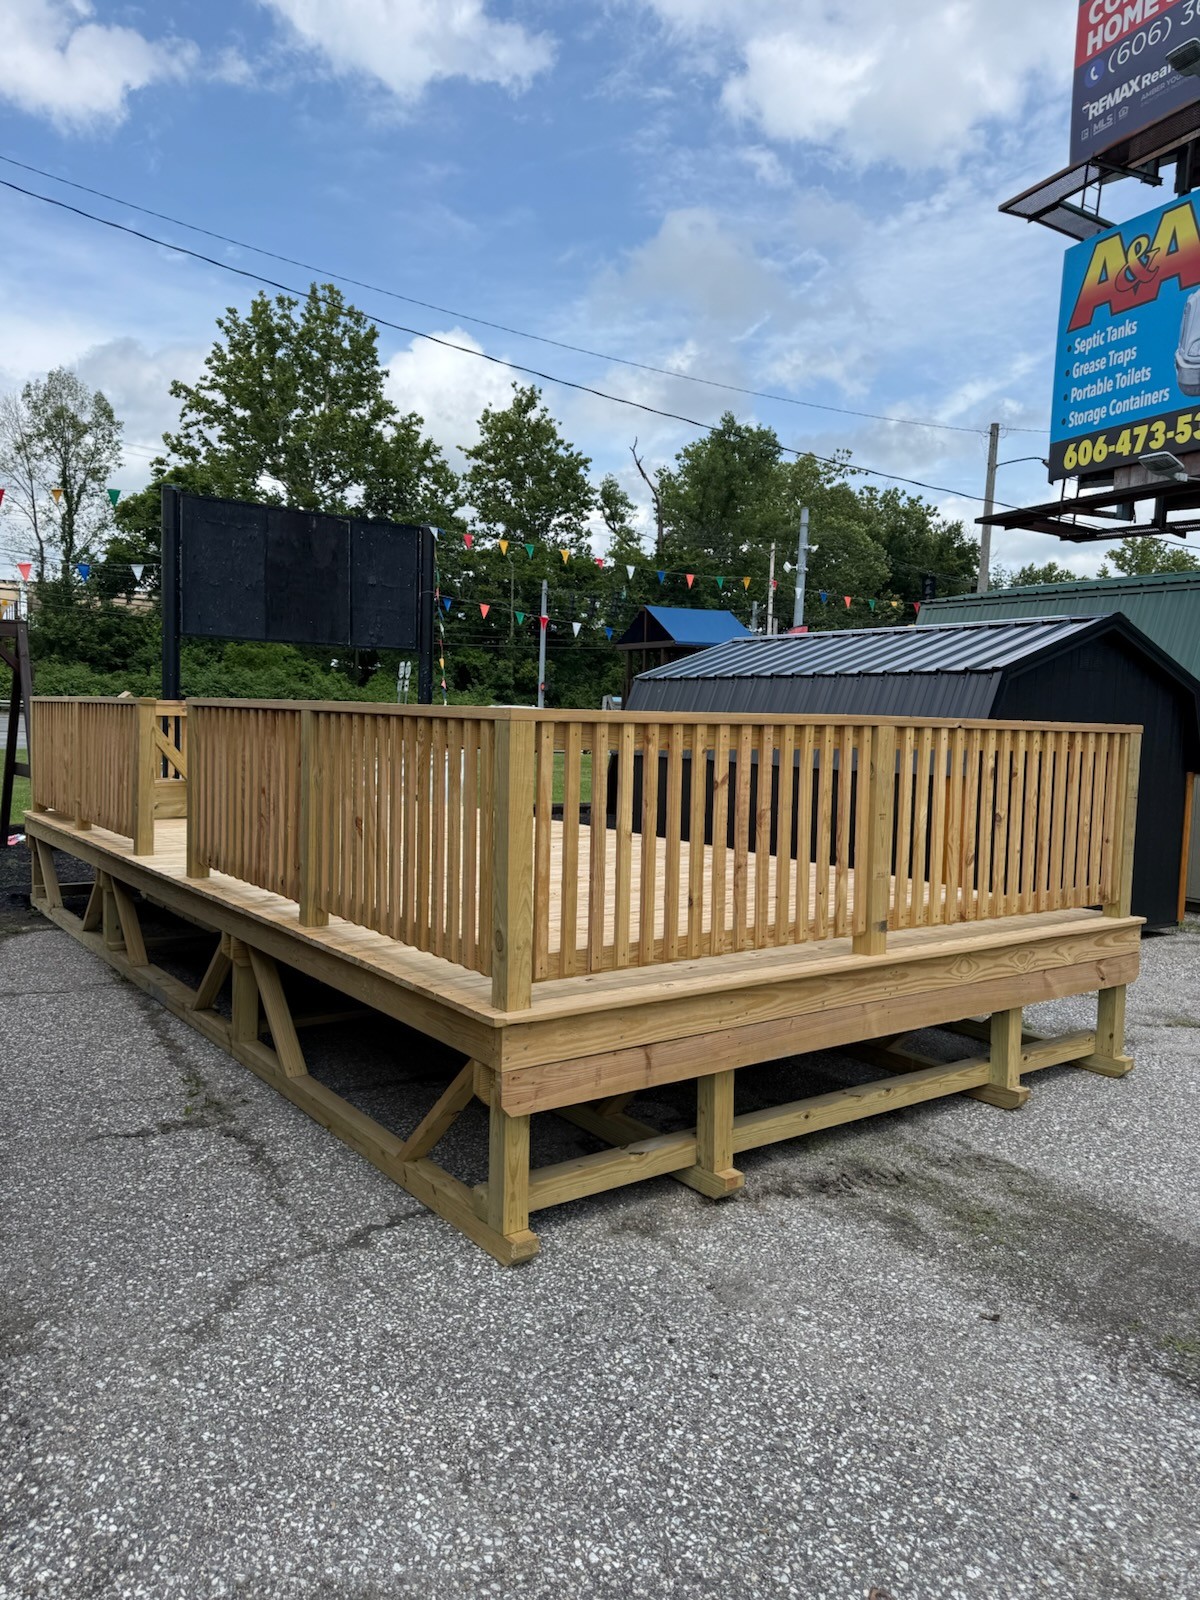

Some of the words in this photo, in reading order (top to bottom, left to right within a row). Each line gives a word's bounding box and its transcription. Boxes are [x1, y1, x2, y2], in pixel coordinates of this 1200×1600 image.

[1108, 16, 1171, 73] (606)
[1180, 0, 1200, 25] 3
[1066, 200, 1200, 333] A&A
[1074, 329, 1105, 355] Septic
[1106, 319, 1138, 343] Tanks
[1072, 357, 1106, 379] Grease
[1108, 346, 1137, 367] Traps
[1070, 376, 1113, 403] Portable
[1115, 366, 1152, 390] Toilets
[1068, 408, 1106, 428] Storage
[1109, 387, 1170, 416] Containers
